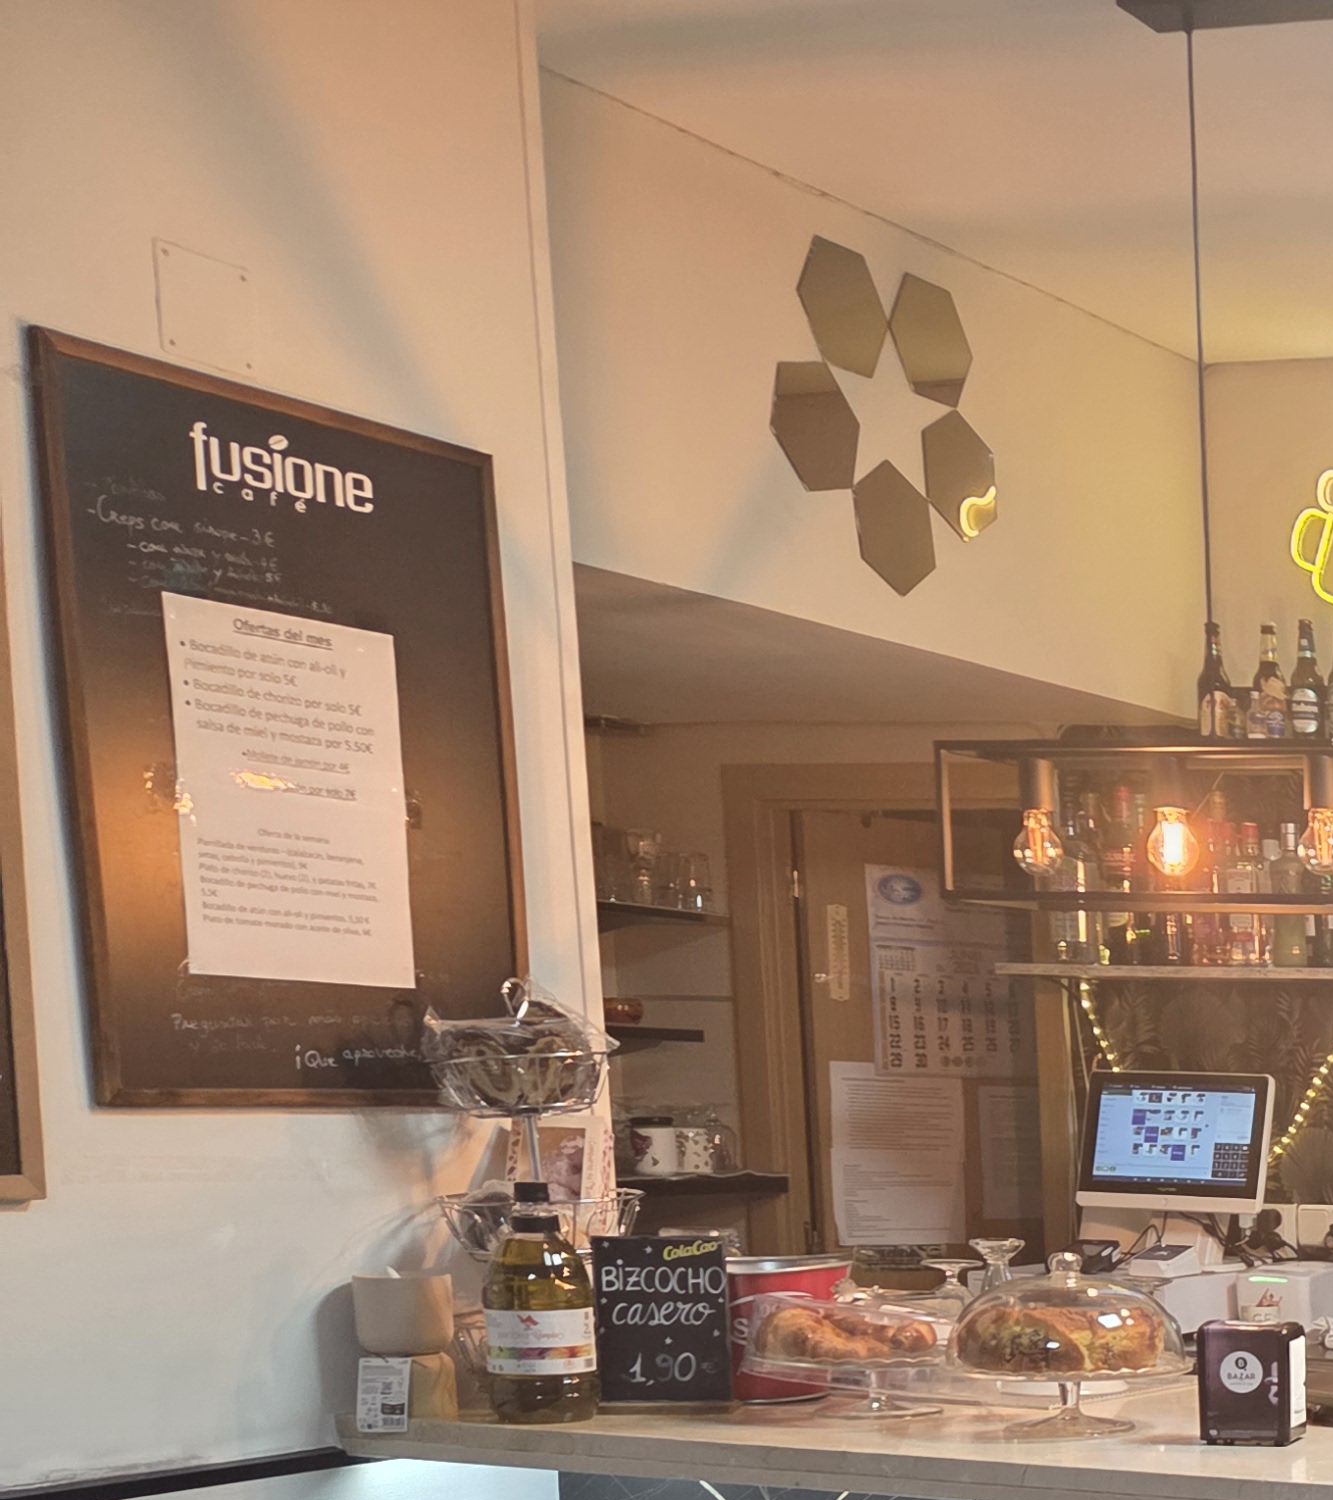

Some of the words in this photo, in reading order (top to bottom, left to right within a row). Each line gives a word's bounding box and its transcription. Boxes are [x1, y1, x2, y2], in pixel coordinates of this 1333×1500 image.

[189, 421, 374, 513] fusione
[212, 481, 307, 514] café
[233, 618, 281, 638] Ofertas
[284, 627, 303, 642] del
[306, 633, 333, 648] mes
[189, 639, 242, 659] Bocadillo
[243, 647, 258, 662] de
[287, 656, 307, 669] con
[237, 667, 256, 680] por
[258, 670, 282, 685] solo
[283, 673, 298, 687] 5€
[193, 678, 244, 698] Bocadillo
[246, 686, 261, 701] de
[263, 689, 302, 707] chorizo
[304, 697, 323, 711] por
[325, 700, 346, 715] solo
[347, 702, 363, 717] 5€
[195, 698, 247, 718] Bocadillo
[249, 706, 263, 721] de
[265, 709, 310, 729] pechuga
[312, 715, 326, 729] de
[328, 718, 354, 734] pollo
[356, 724, 375, 737] con
[196, 718, 224, 733] salsa
[226, 722, 241, 735] de
[279, 732, 322, 748] mostaza
[325, 738, 343, 751] por
[663, 1239, 719, 1261] ColaCao
[601, 1258, 727, 1295] BIZCOCHO
[612, 1301, 717, 1327] casero
[628, 1352, 697, 1386] 1,90
[1227, 1372, 1256, 1380] BAZAR
